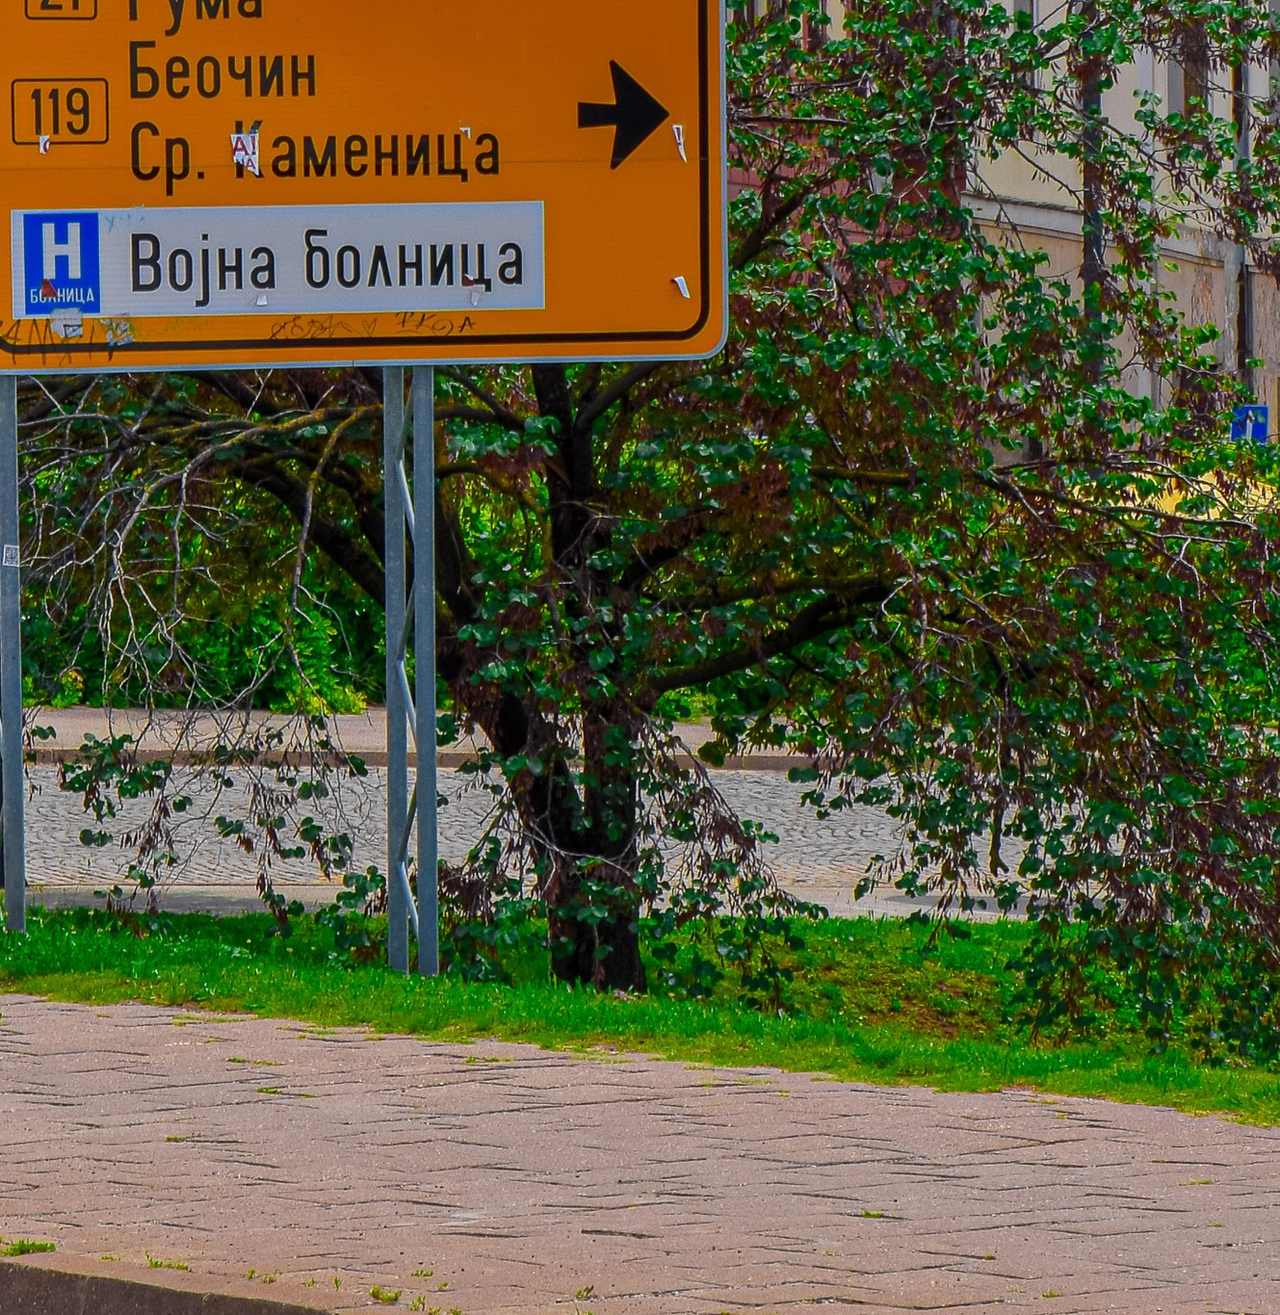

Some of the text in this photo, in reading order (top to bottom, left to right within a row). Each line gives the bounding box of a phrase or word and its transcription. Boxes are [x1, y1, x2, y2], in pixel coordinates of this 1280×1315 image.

[30, 40, 317, 136] 119 Беочин
[130, 120, 206, 197] Ср.
[130, 228, 523, 308] Војна болница
